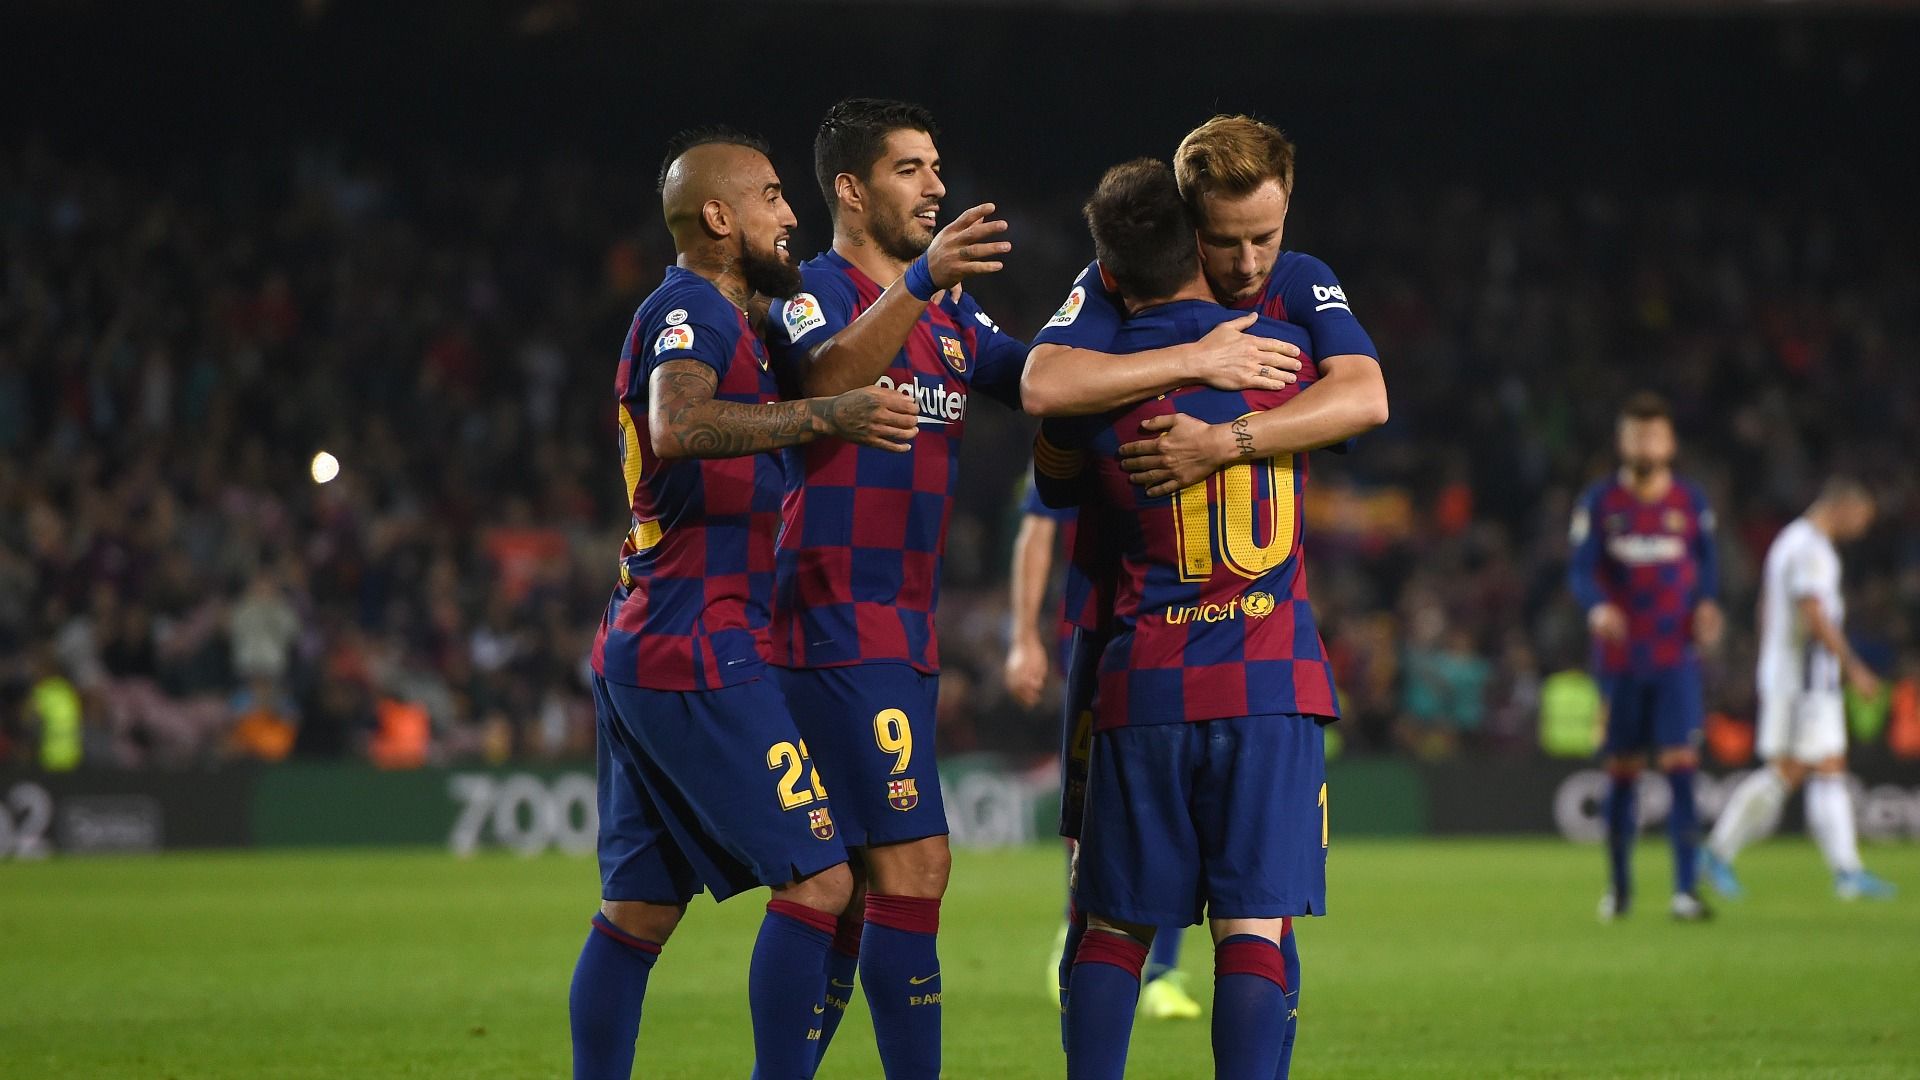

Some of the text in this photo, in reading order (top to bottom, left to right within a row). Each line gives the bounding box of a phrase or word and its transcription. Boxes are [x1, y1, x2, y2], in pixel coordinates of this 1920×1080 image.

[1170, 450, 1296, 583] 10
[1165, 594, 1240, 625] unicef
[873, 707, 913, 775] 9
[450, 772, 599, 860] 700
